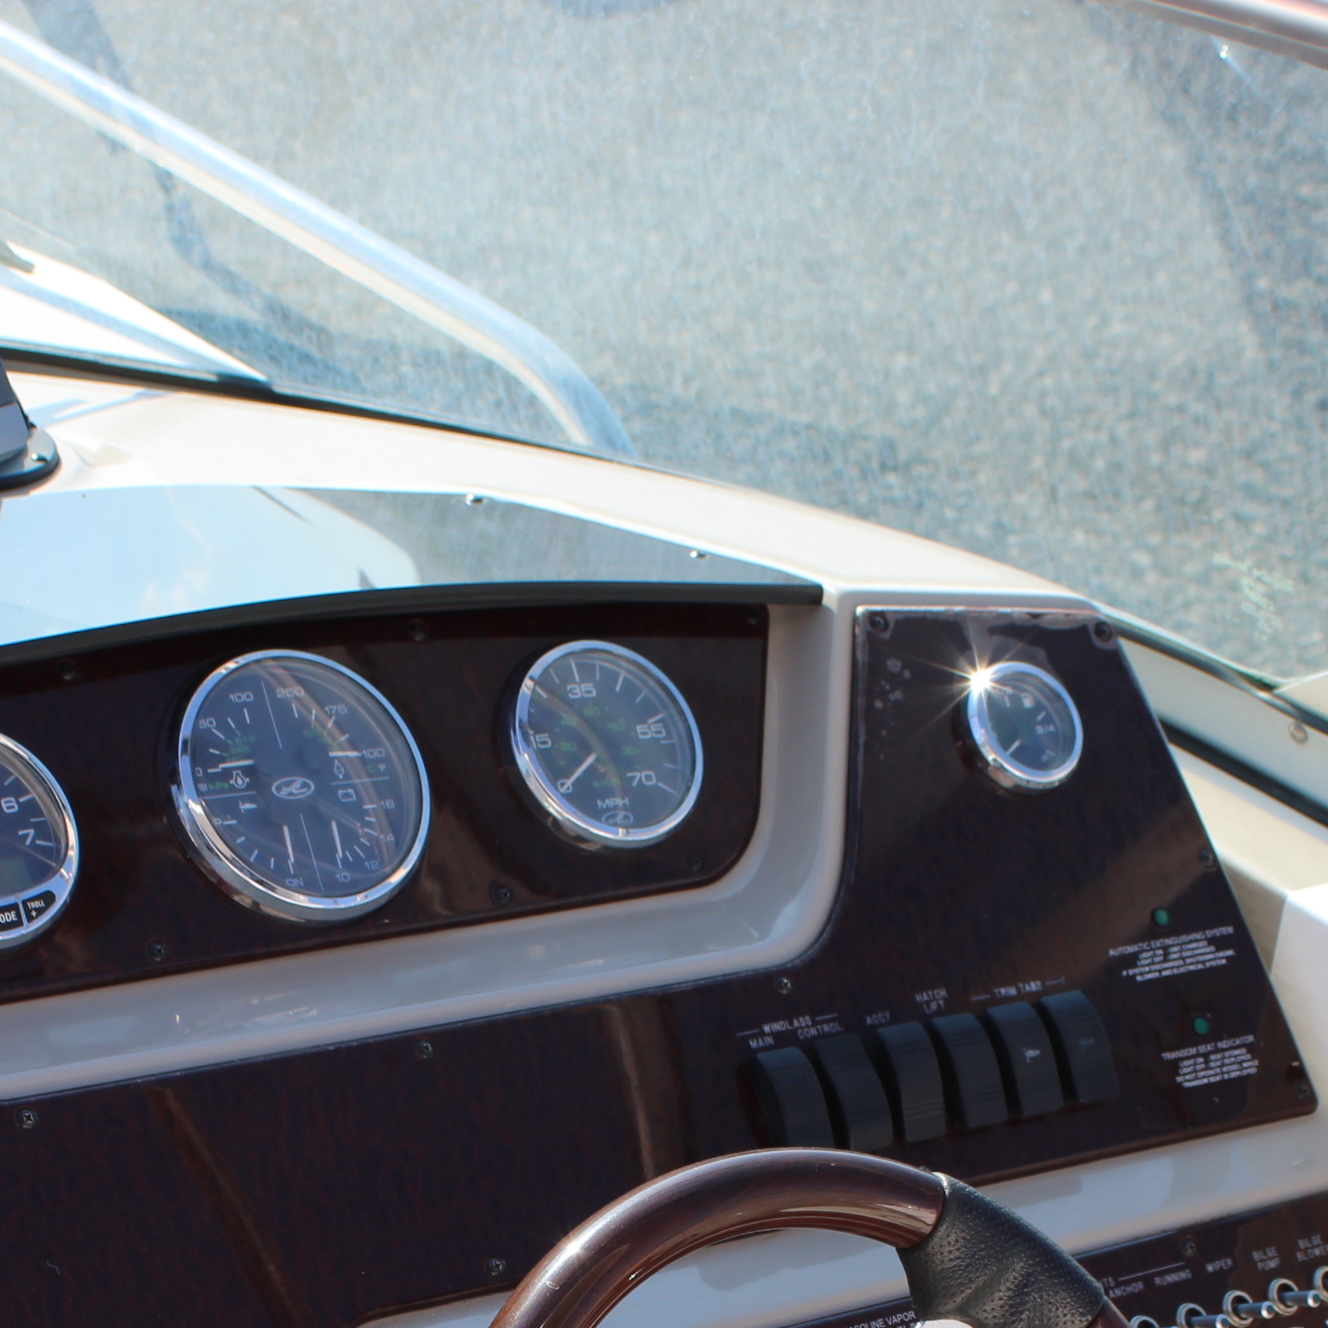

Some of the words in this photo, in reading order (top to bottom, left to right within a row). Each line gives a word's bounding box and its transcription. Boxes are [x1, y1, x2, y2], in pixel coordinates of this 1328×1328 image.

[229, 691, 253, 703] 100
[276, 687, 304, 698] 250
[566, 683, 596, 698] 35
[325, 705, 348, 715] 175
[199, 718, 216, 729] 50
[195, 767, 203, 777] 0
[626, 771, 656, 787] 70
[557, 779, 572, 793] 0
[0, 797, 19, 813] 6
[597, 798, 629, 809] MPH
[18, 829, 35, 846] 7
[335, 873, 350, 883] 10
[27, 900, 45, 909] TROLL
[1109, 942, 1149, 956] AUTOMATIC
[1151, 931, 1203, 948] EXTINGUISHING
[1206, 925, 1232, 937] SYSTEM
[914, 988, 948, 1002] HATCH
[923, 999, 946, 1013] LIFT
[762, 1014, 813, 1034] WINDLASS
[797, 1022, 844, 1039] CONTROL
[749, 1036, 774, 1049] MAIN
[1162, 1047, 1196, 1060] TRANSOM
[1198, 1043, 1214, 1052] SEAT
[1217, 1035, 1254, 1048] INDICATOR
[1297, 1236, 1323, 1249] BILGE
[1253, 1248, 1279, 1261] BILGE
[1206, 1259, 1233, 1273] WIPER
[1256, 1257, 1280, 1271] PUMP
[1154, 1270, 1193, 1287] RUNNING
[1109, 1281, 1144, 1296] ANCHOR
[887, 1310, 914, 1324] VAPOR
